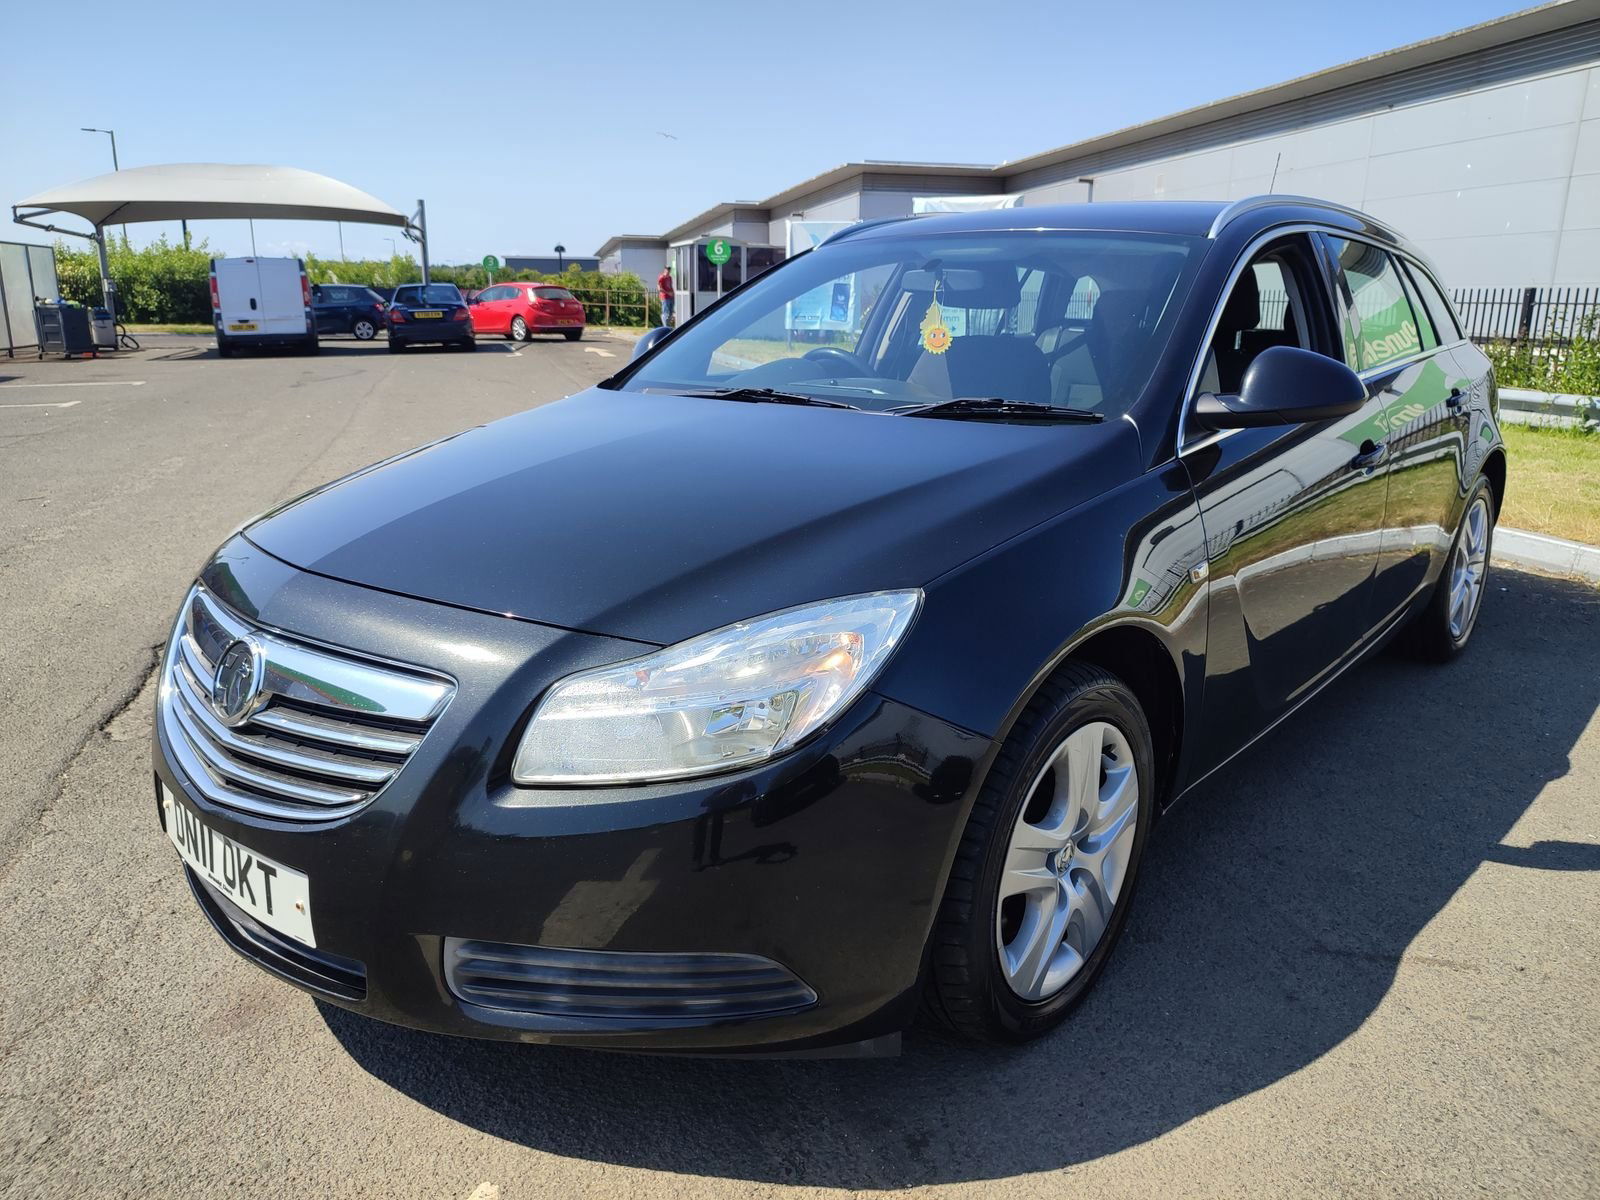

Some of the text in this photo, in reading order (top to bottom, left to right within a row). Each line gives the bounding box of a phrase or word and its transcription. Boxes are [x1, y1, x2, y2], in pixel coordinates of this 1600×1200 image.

[714, 240, 724, 255] 6
[487, 256, 495, 267] 3
[222, 836, 278, 917] DKT
